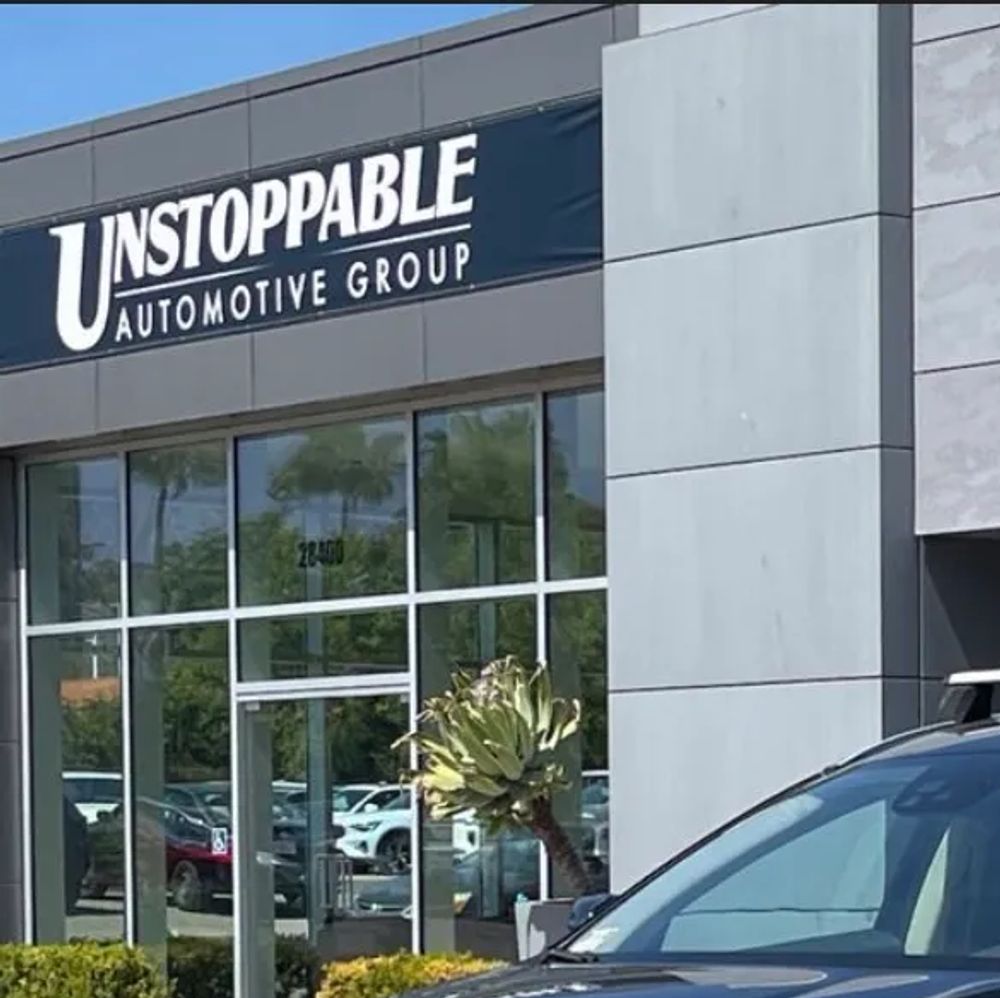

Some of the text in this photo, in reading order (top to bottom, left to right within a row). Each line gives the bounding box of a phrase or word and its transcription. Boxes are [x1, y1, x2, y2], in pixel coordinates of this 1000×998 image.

[49, 133, 477, 351] UNSTOPPABLE
[115, 242, 471, 342] AUTOMOTIVE GROUP
